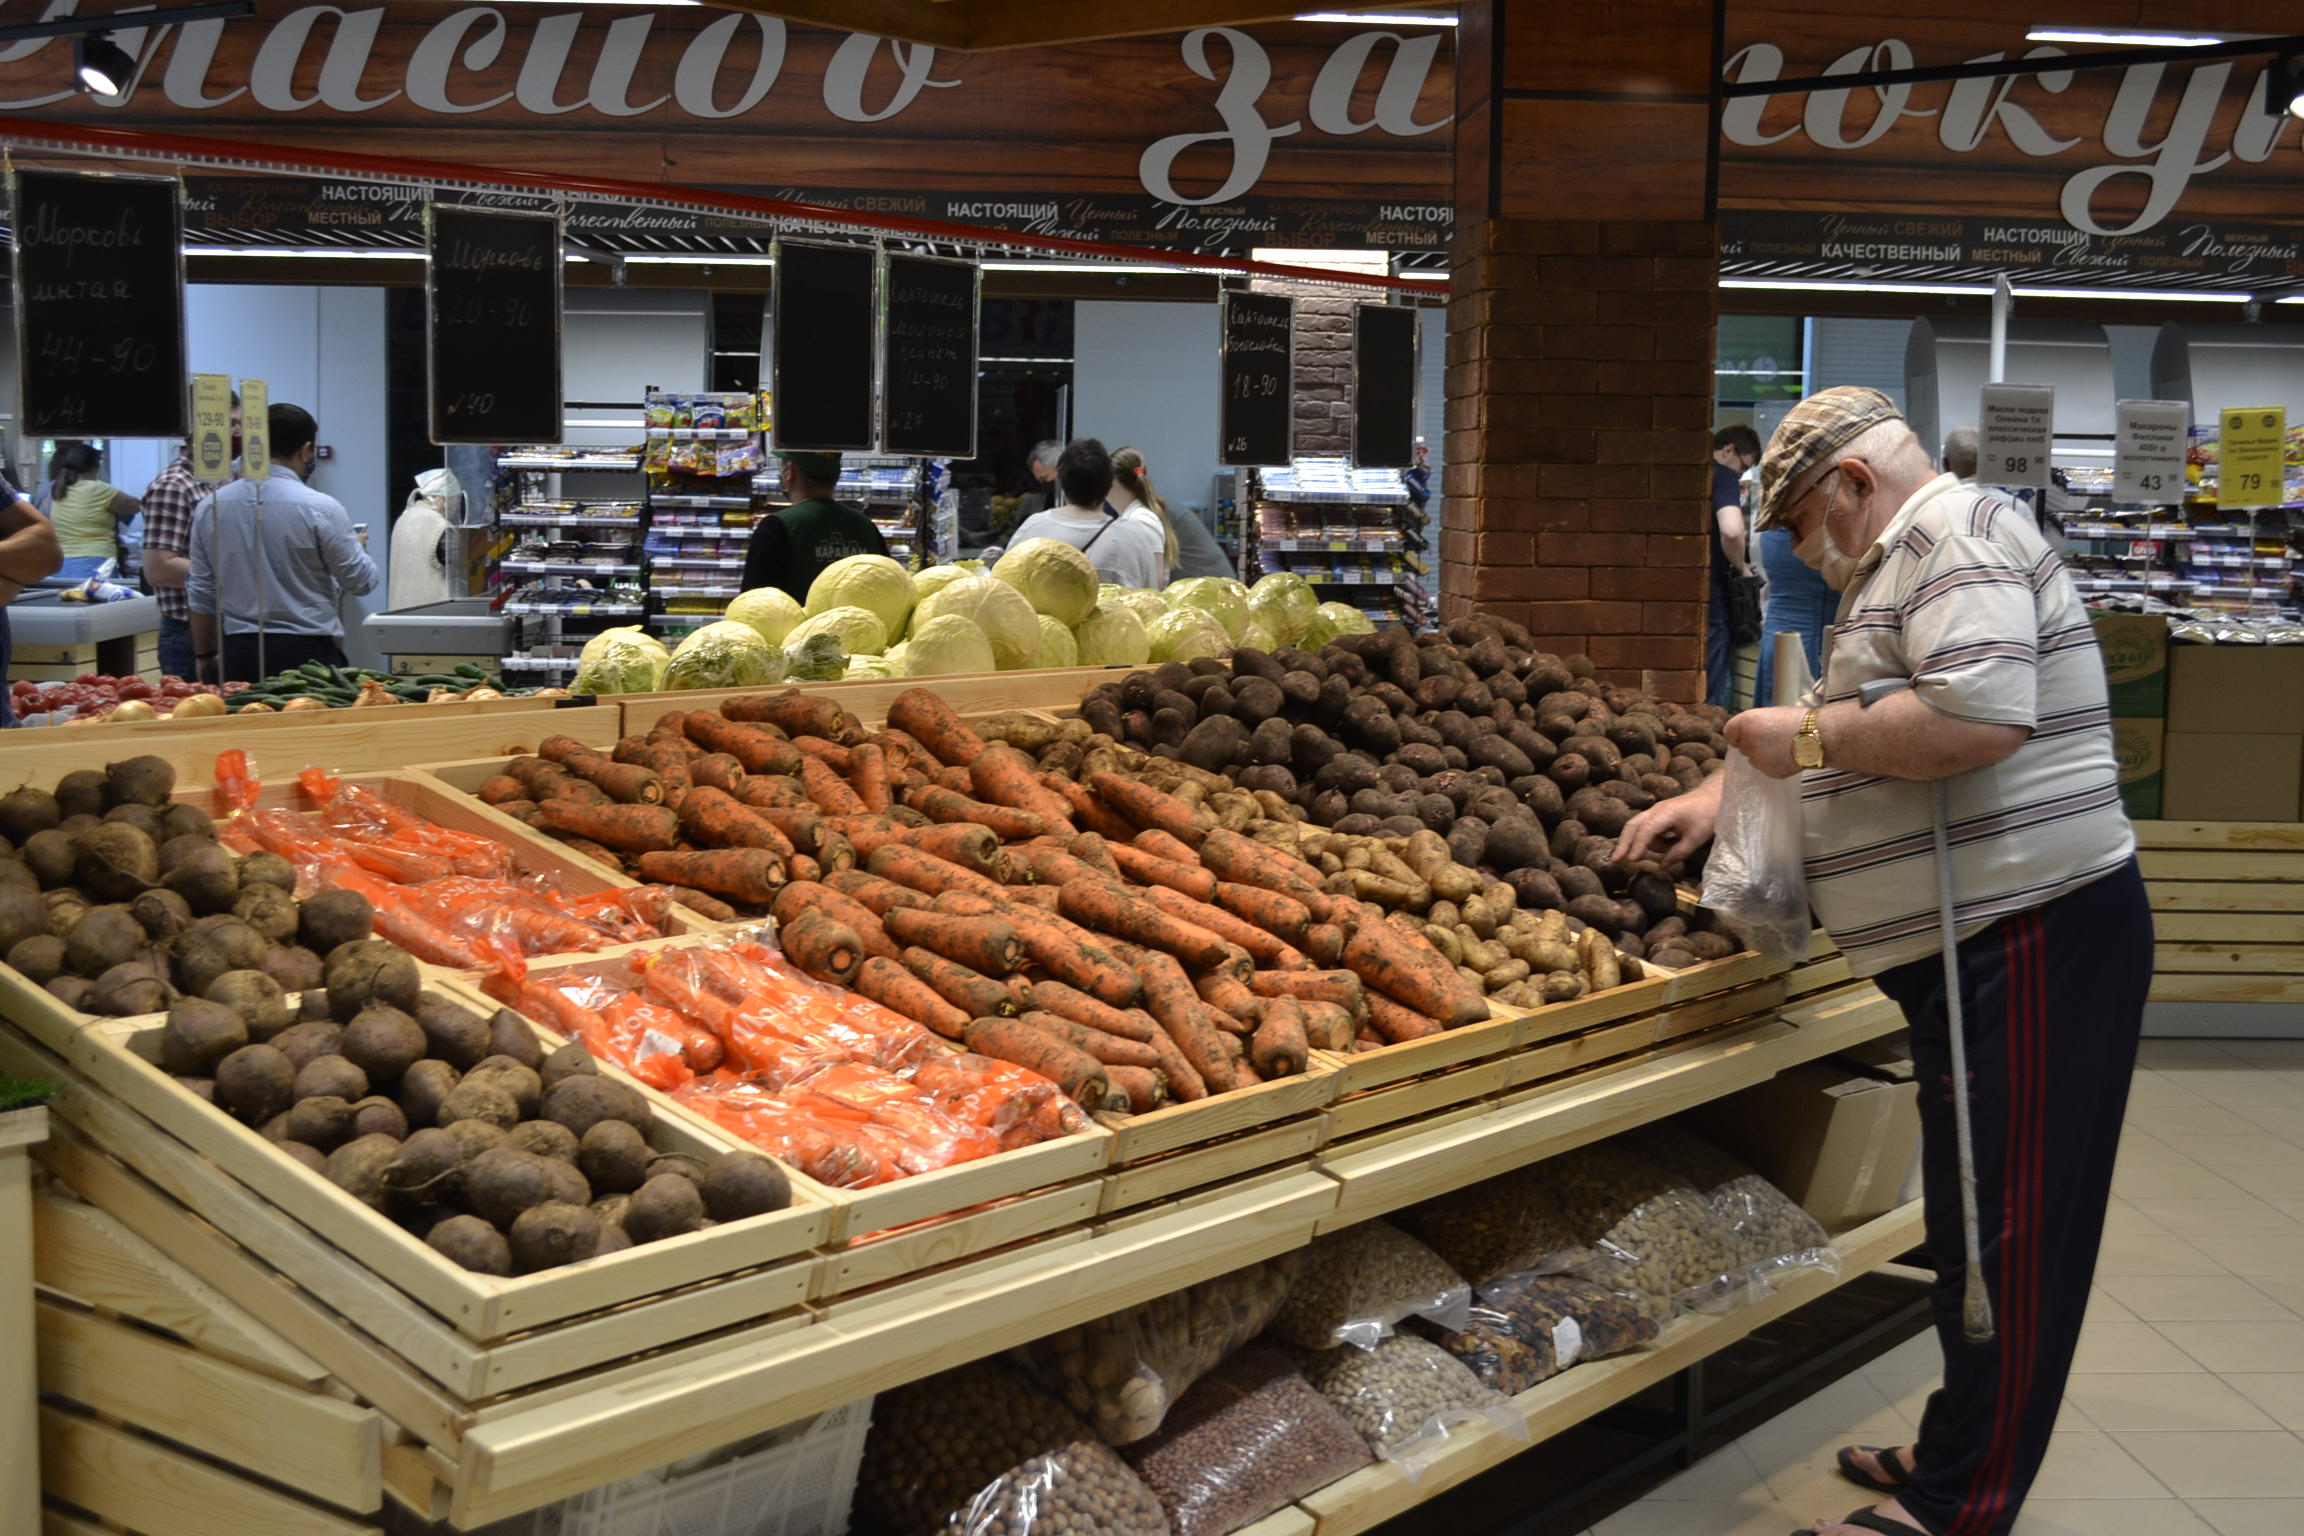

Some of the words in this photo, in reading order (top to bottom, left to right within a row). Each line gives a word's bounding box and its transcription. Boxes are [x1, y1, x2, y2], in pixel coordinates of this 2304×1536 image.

[1138, 27, 1456, 206] за
[854, 194, 926, 213] СВЕЖИЙ
[946, 200, 1060, 222] НАСТОЯЩИЙ
[307, 209, 382, 226] МЕСТНЫЙ
[1110, 229, 1180, 243] ПОЛЕЗНЫЙ
[1365, 230, 1438, 247] МЕСТНЫЙ
[1893, 221, 1963, 239] СВЕЖИЙ
[1983, 226, 2090, 247] НАСТОЯЩИЙ
[1820, 241, 1961, 262] КАЧЕСТВЕННЫЙ
[1971, 247, 2042, 264] МЕСТНЫЙ
[2129, 422, 2177, 432] Макароны
[2005, 457, 2028, 473] 98
[2139, 475, 2162, 490] 43
[2240, 474, 2261, 490] 79
